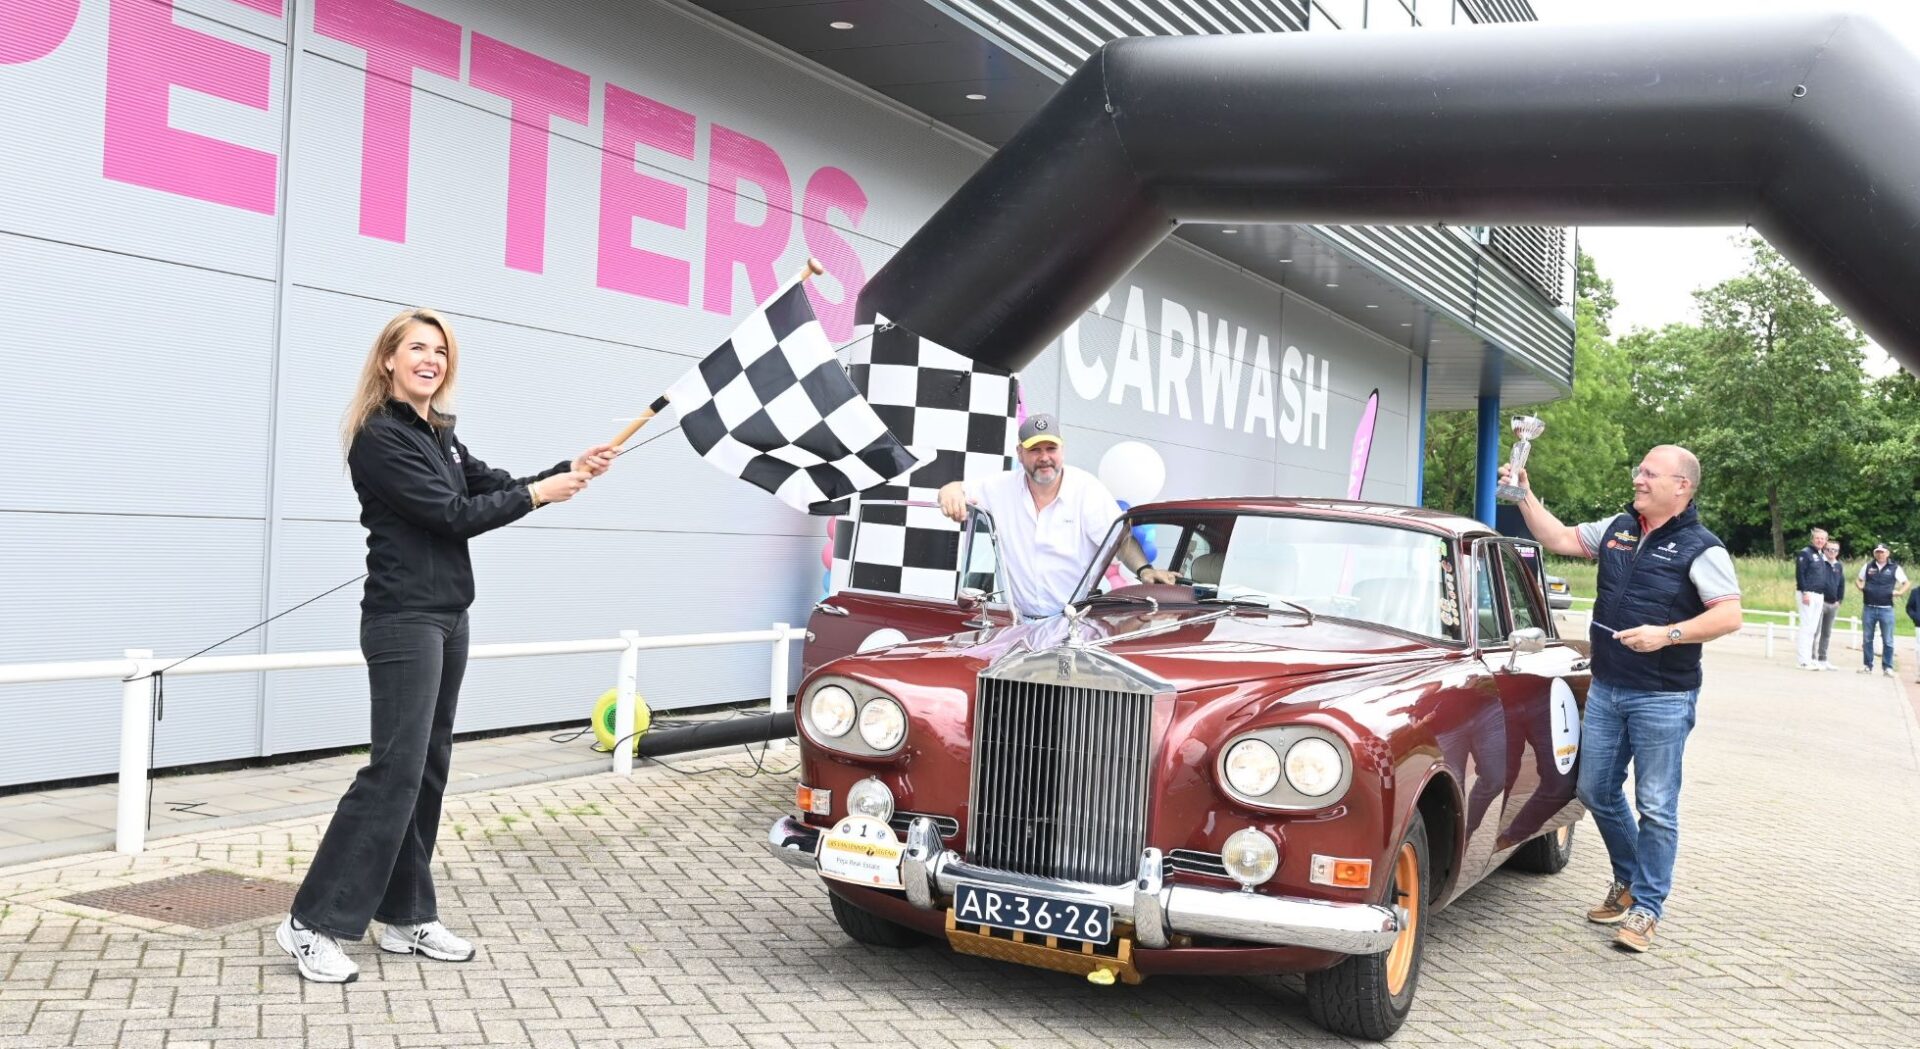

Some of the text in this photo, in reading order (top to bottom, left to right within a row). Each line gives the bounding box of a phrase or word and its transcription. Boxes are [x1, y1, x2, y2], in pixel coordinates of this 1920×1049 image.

[0, 0, 868, 343] ETTERS
[1062, 285, 1329, 450] CARWASH
[1561, 700, 1569, 733] 1
[859, 824, 867, 837] 1
[960, 889, 1102, 938] AR-36-26
